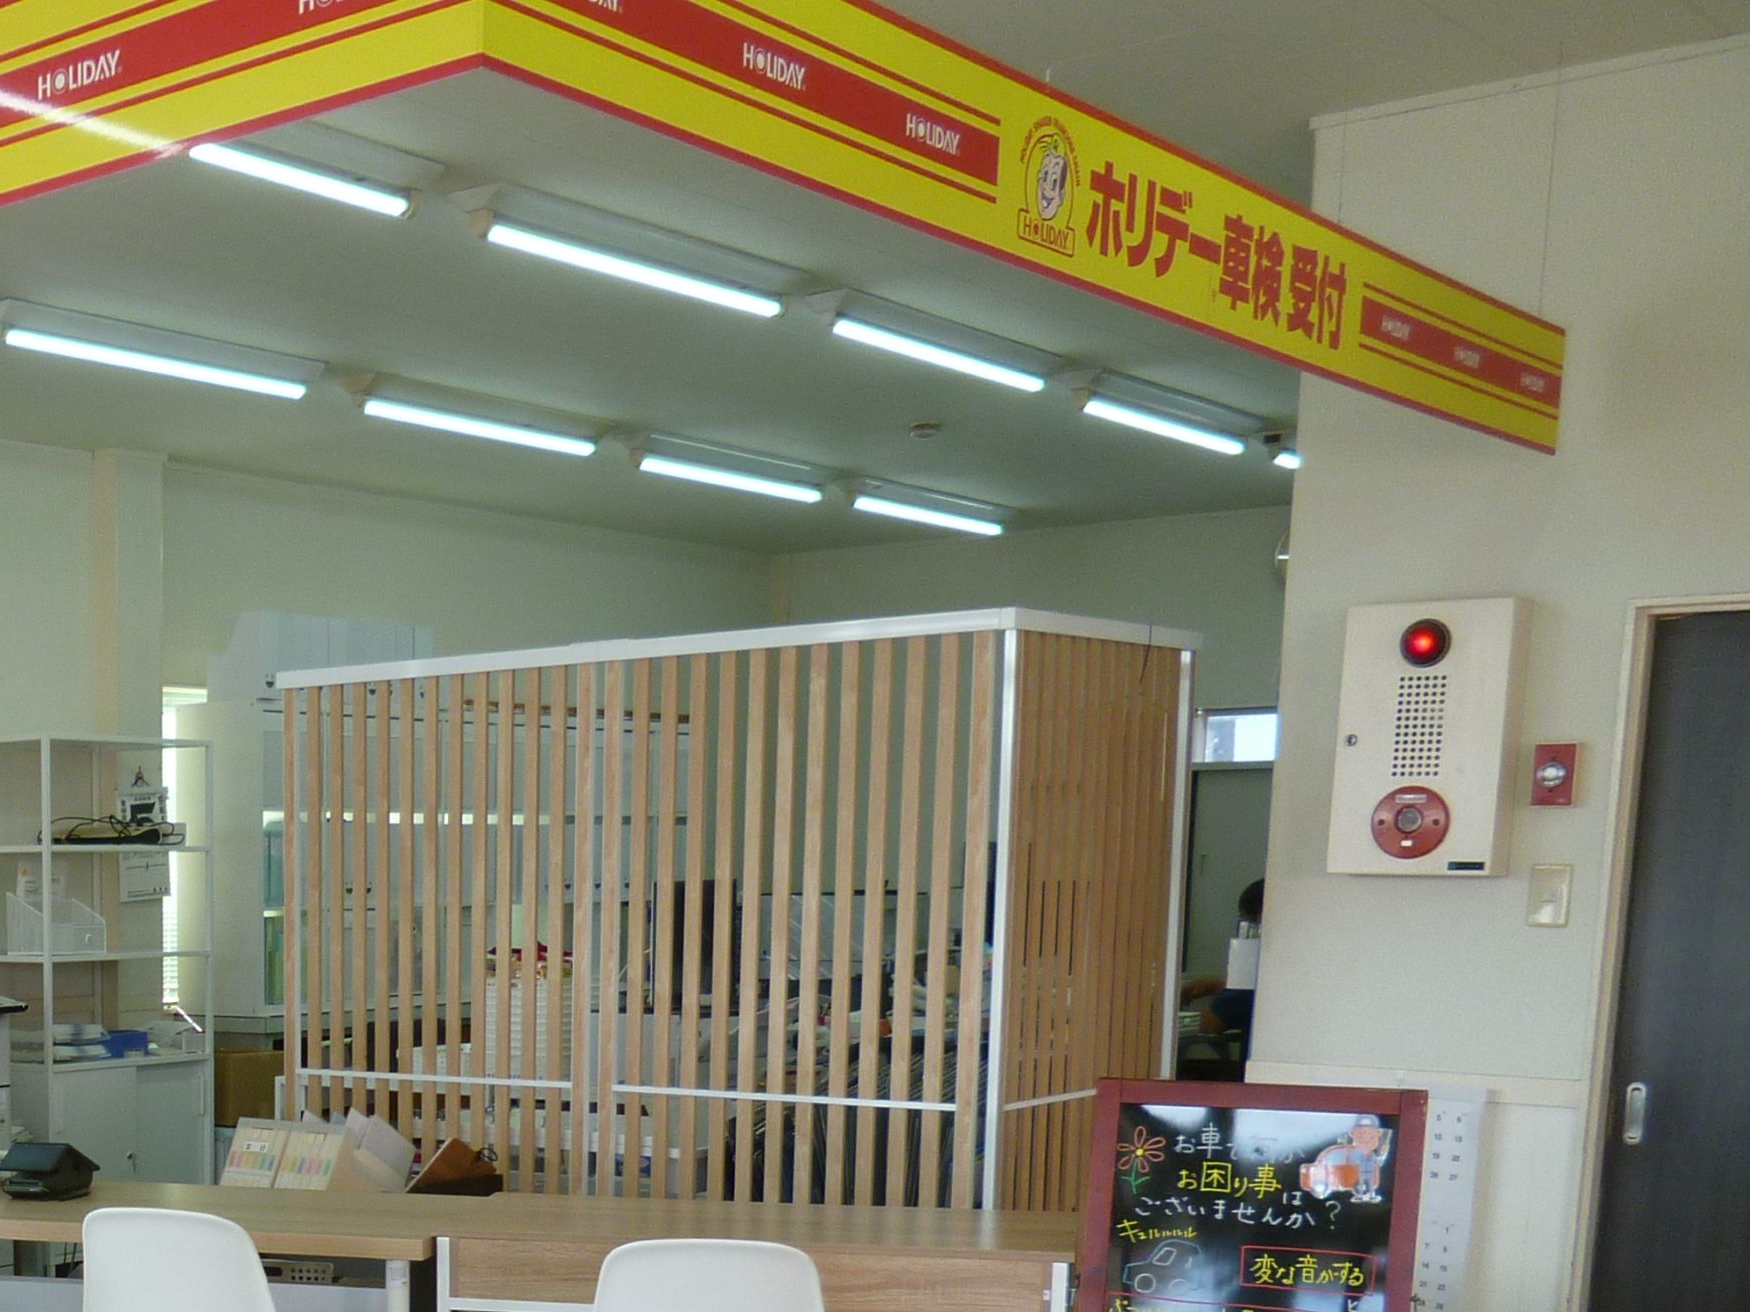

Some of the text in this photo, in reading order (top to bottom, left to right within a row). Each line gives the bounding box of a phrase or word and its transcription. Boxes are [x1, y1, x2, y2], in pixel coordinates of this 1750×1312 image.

[38, 50, 122, 100] HOLIDAY
[743, 42, 807, 92] HOLIDAY
[906, 113, 961, 156] HOLIDAY
[1023, 215, 1069, 250] HOLIDAY
[1250, 1253, 1365, 1286] 変な音がする
